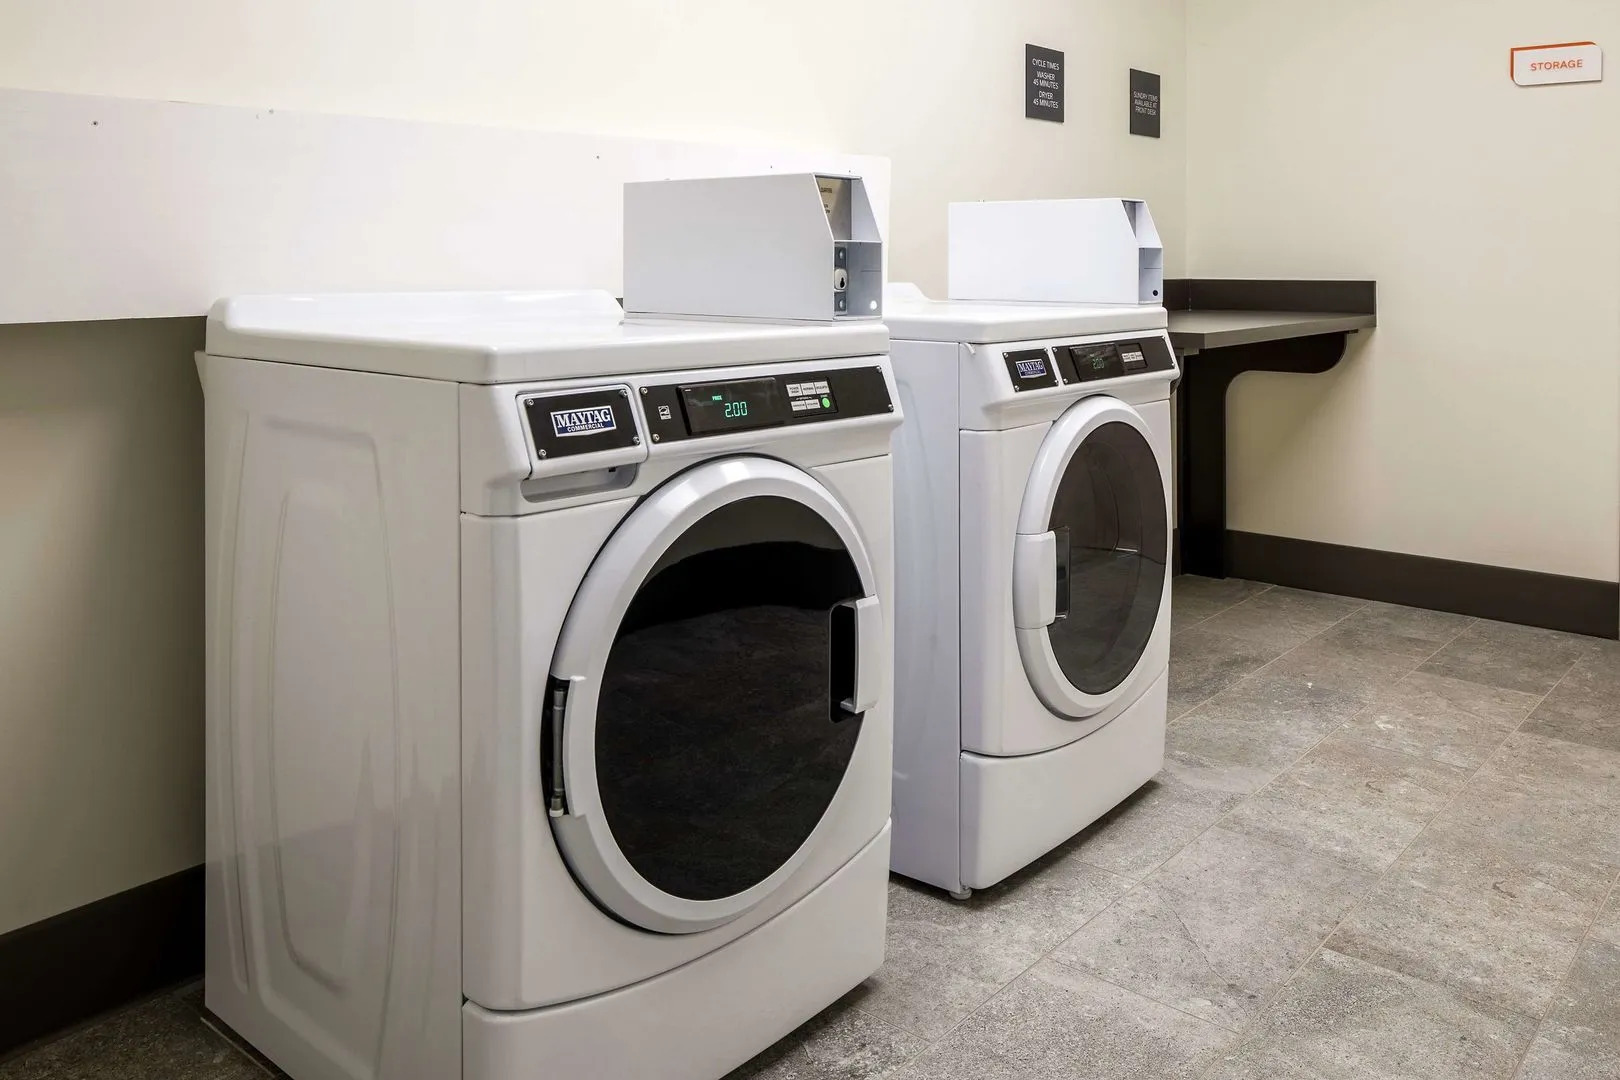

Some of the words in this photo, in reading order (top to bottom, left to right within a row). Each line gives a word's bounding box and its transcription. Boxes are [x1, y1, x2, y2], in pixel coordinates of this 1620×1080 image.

[1032, 58, 1046, 68] CYCLE
[1047, 61, 1060, 71] TIMES
[1530, 59, 1583, 71] STORAGE
[1037, 71, 1055, 80] WASHER
[1033, 78, 1039, 86] 45
[1039, 79, 1059, 90] MINUTES
[1038, 90, 1053, 100] DRYER
[1033, 98, 1039, 106] 45
[1039, 99, 1059, 109] MINUTES
[1018, 361, 1043, 372] MAYTAG
[724, 401, 748, 418] 2.00
[554, 409, 611, 428] MAYTAG
[567, 422, 604, 433] COMMERCIAL
